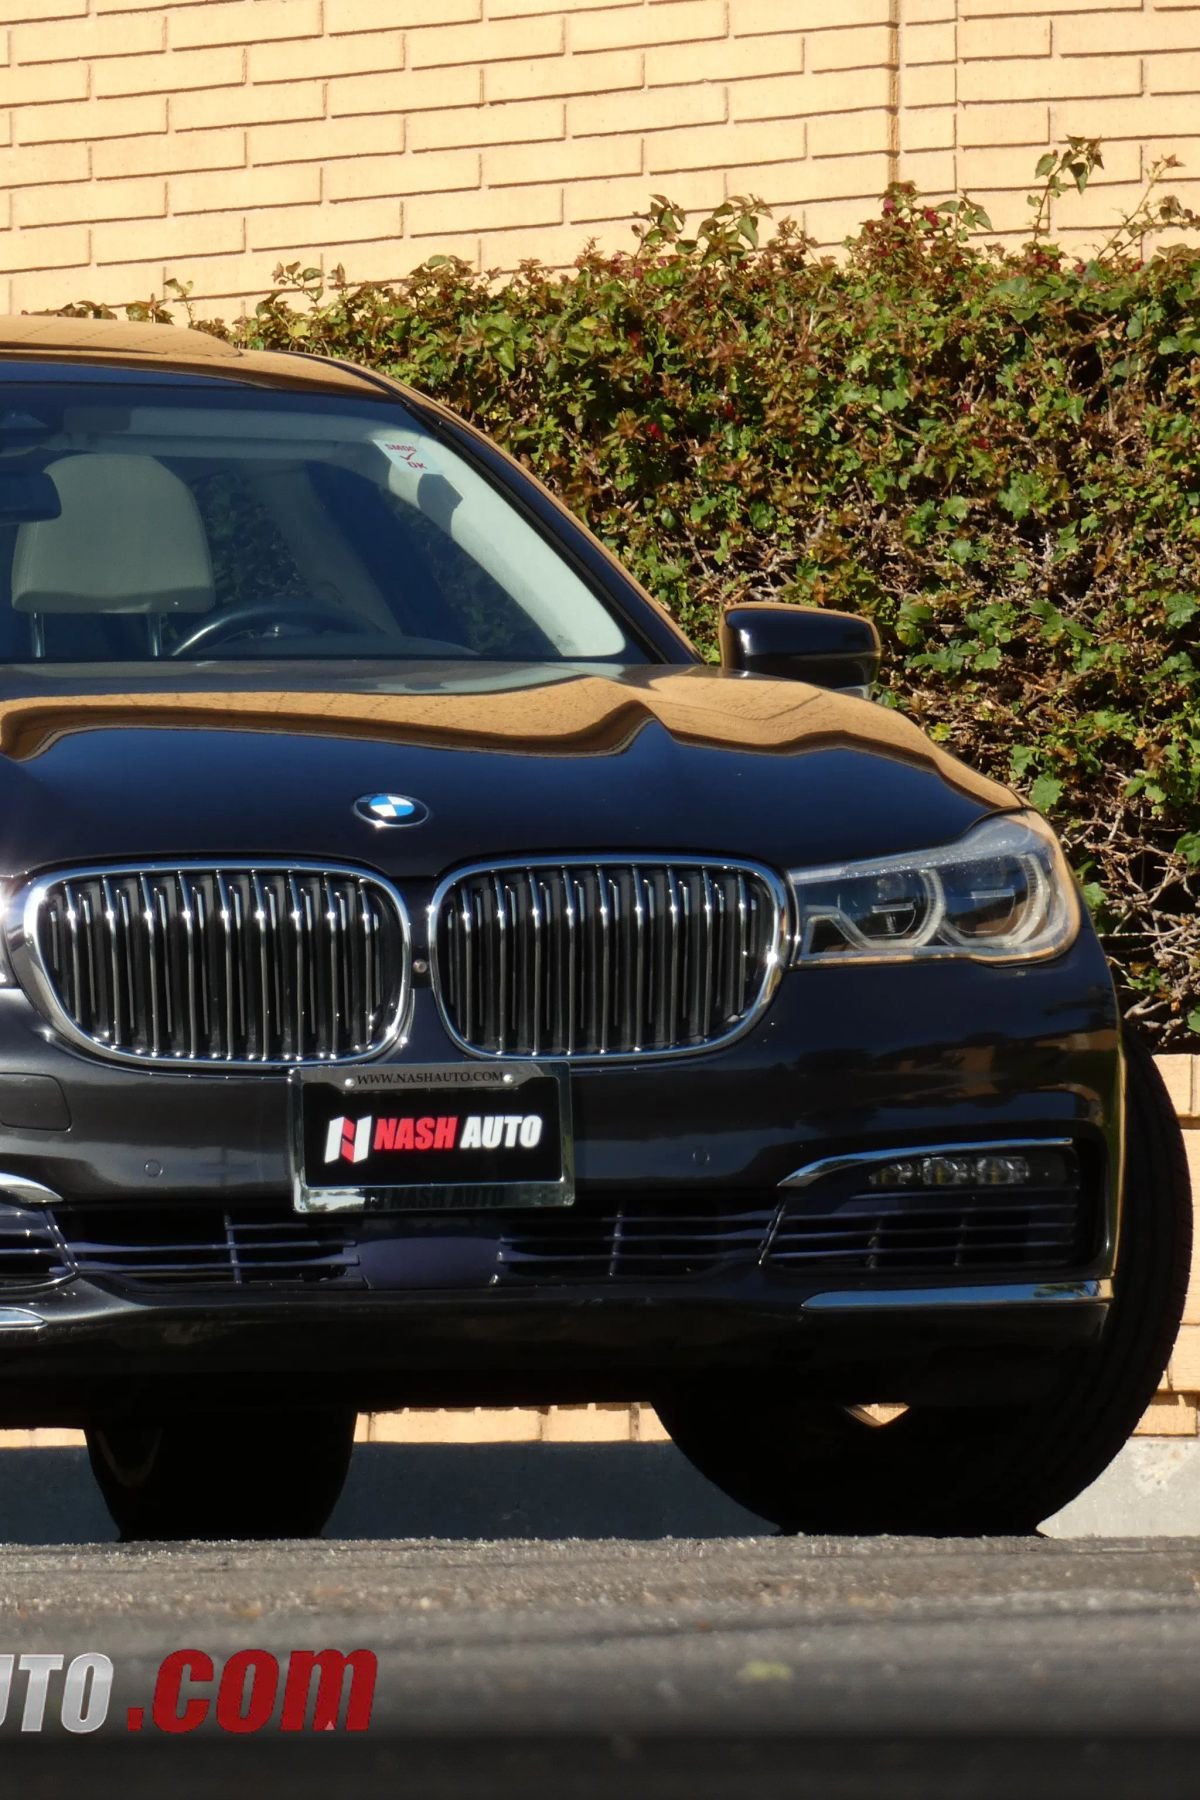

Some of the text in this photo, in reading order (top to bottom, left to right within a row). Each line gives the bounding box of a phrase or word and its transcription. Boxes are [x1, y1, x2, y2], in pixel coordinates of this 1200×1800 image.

[356, 1070, 504, 1085] WWW.NASHAUTO.COM
[373, 1116, 459, 1151] NASH
[459, 1114, 544, 1149] AUTO
